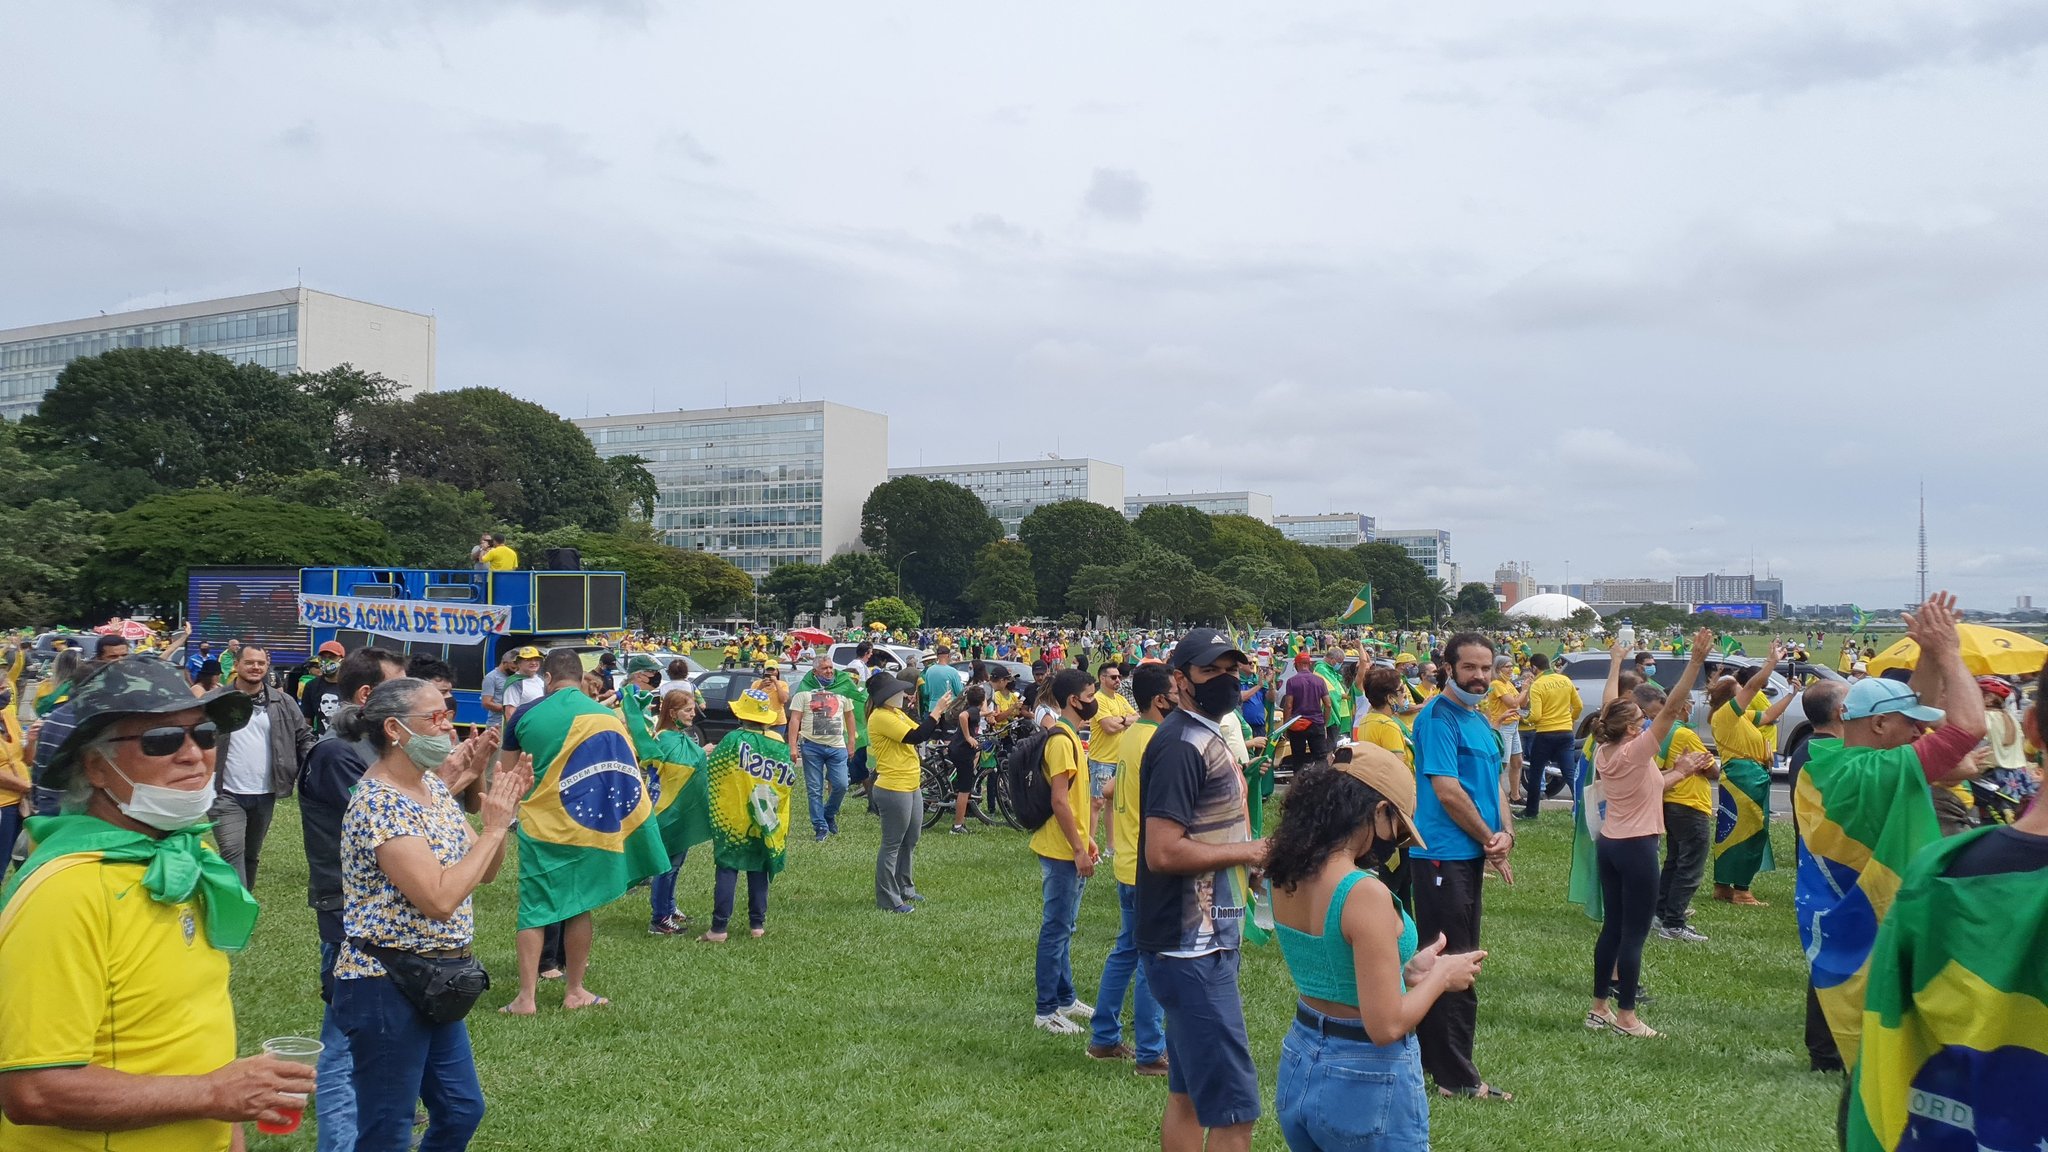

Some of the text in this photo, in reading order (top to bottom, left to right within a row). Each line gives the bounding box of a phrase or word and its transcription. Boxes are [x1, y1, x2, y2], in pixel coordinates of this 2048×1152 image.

[304, 600, 495, 637] DEUS ACIMA DE TUDO
[560, 769, 591, 788] ORDEM
[1210, 906, 1217, 919] O
